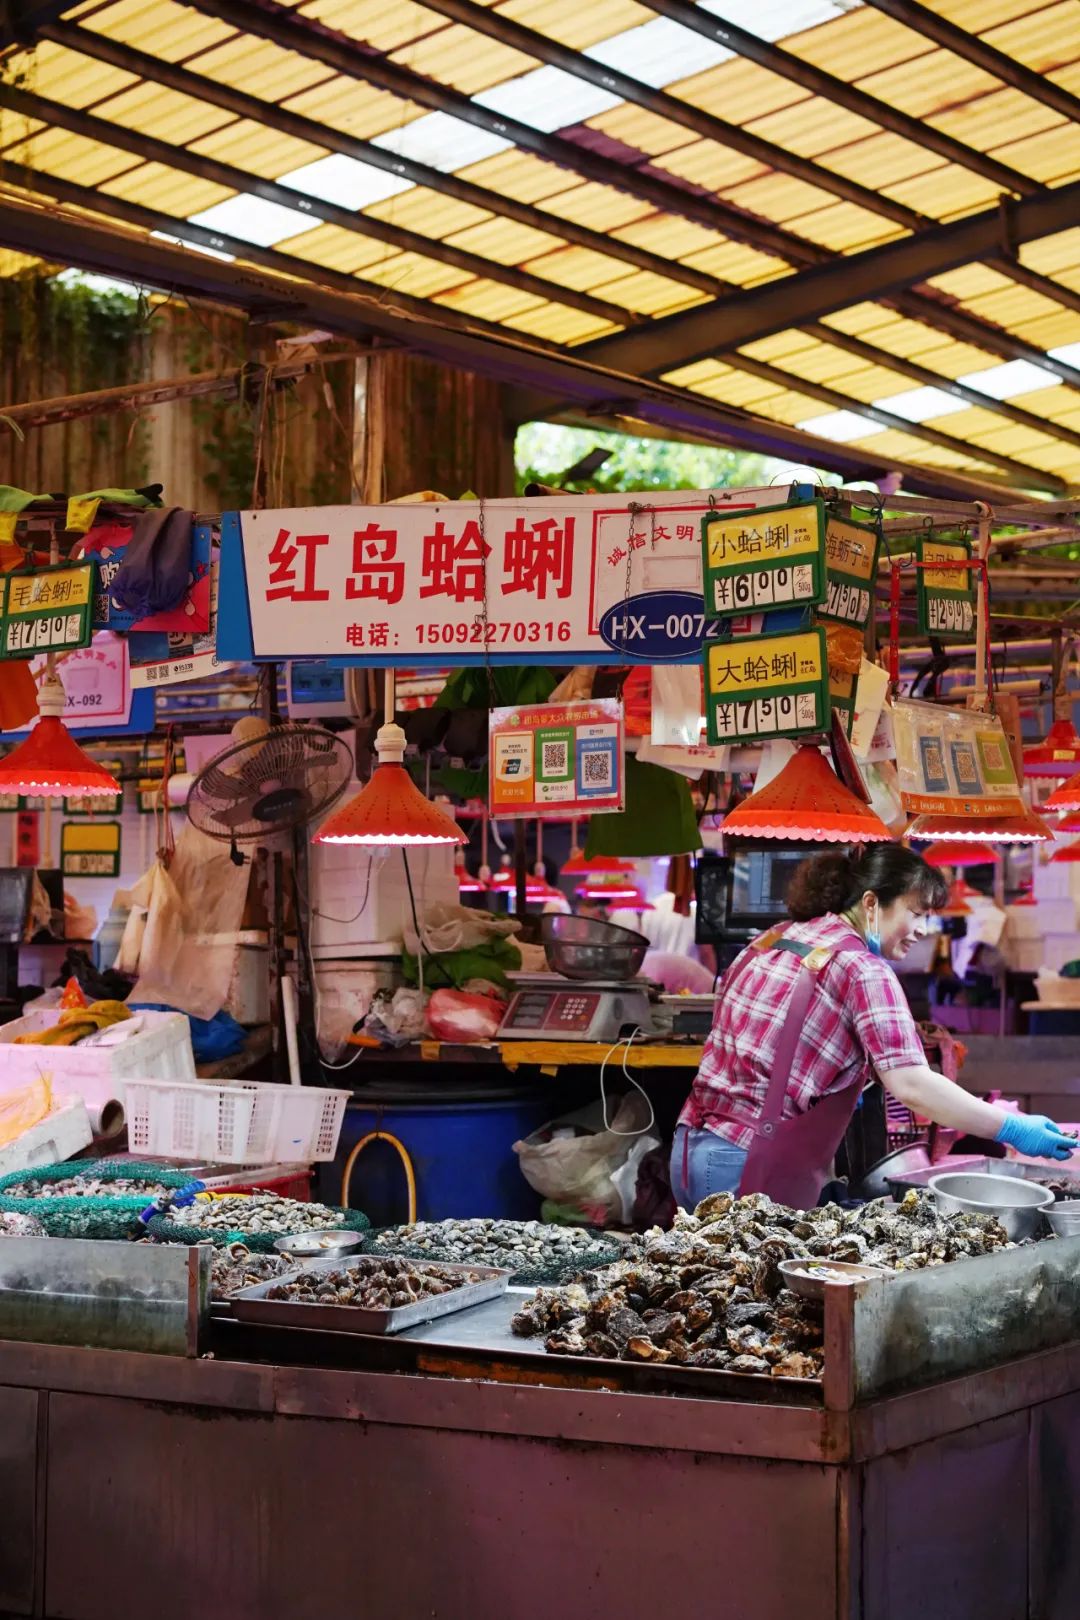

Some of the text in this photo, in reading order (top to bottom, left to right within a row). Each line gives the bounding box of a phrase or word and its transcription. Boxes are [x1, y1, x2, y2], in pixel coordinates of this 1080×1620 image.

[607, 524, 704, 567] 诚信文明
[712, 523, 790, 559] 小蛤蜊
[265, 516, 576, 605] 红岛蛤蜊
[13, 579, 72, 606] 毛蛤蜊
[415, 621, 572, 644] 15092270316
[611, 614, 718, 640] HX-0072
[717, 652, 797, 685] 大蛤蜊
[63, 694, 102, 708] X-092
